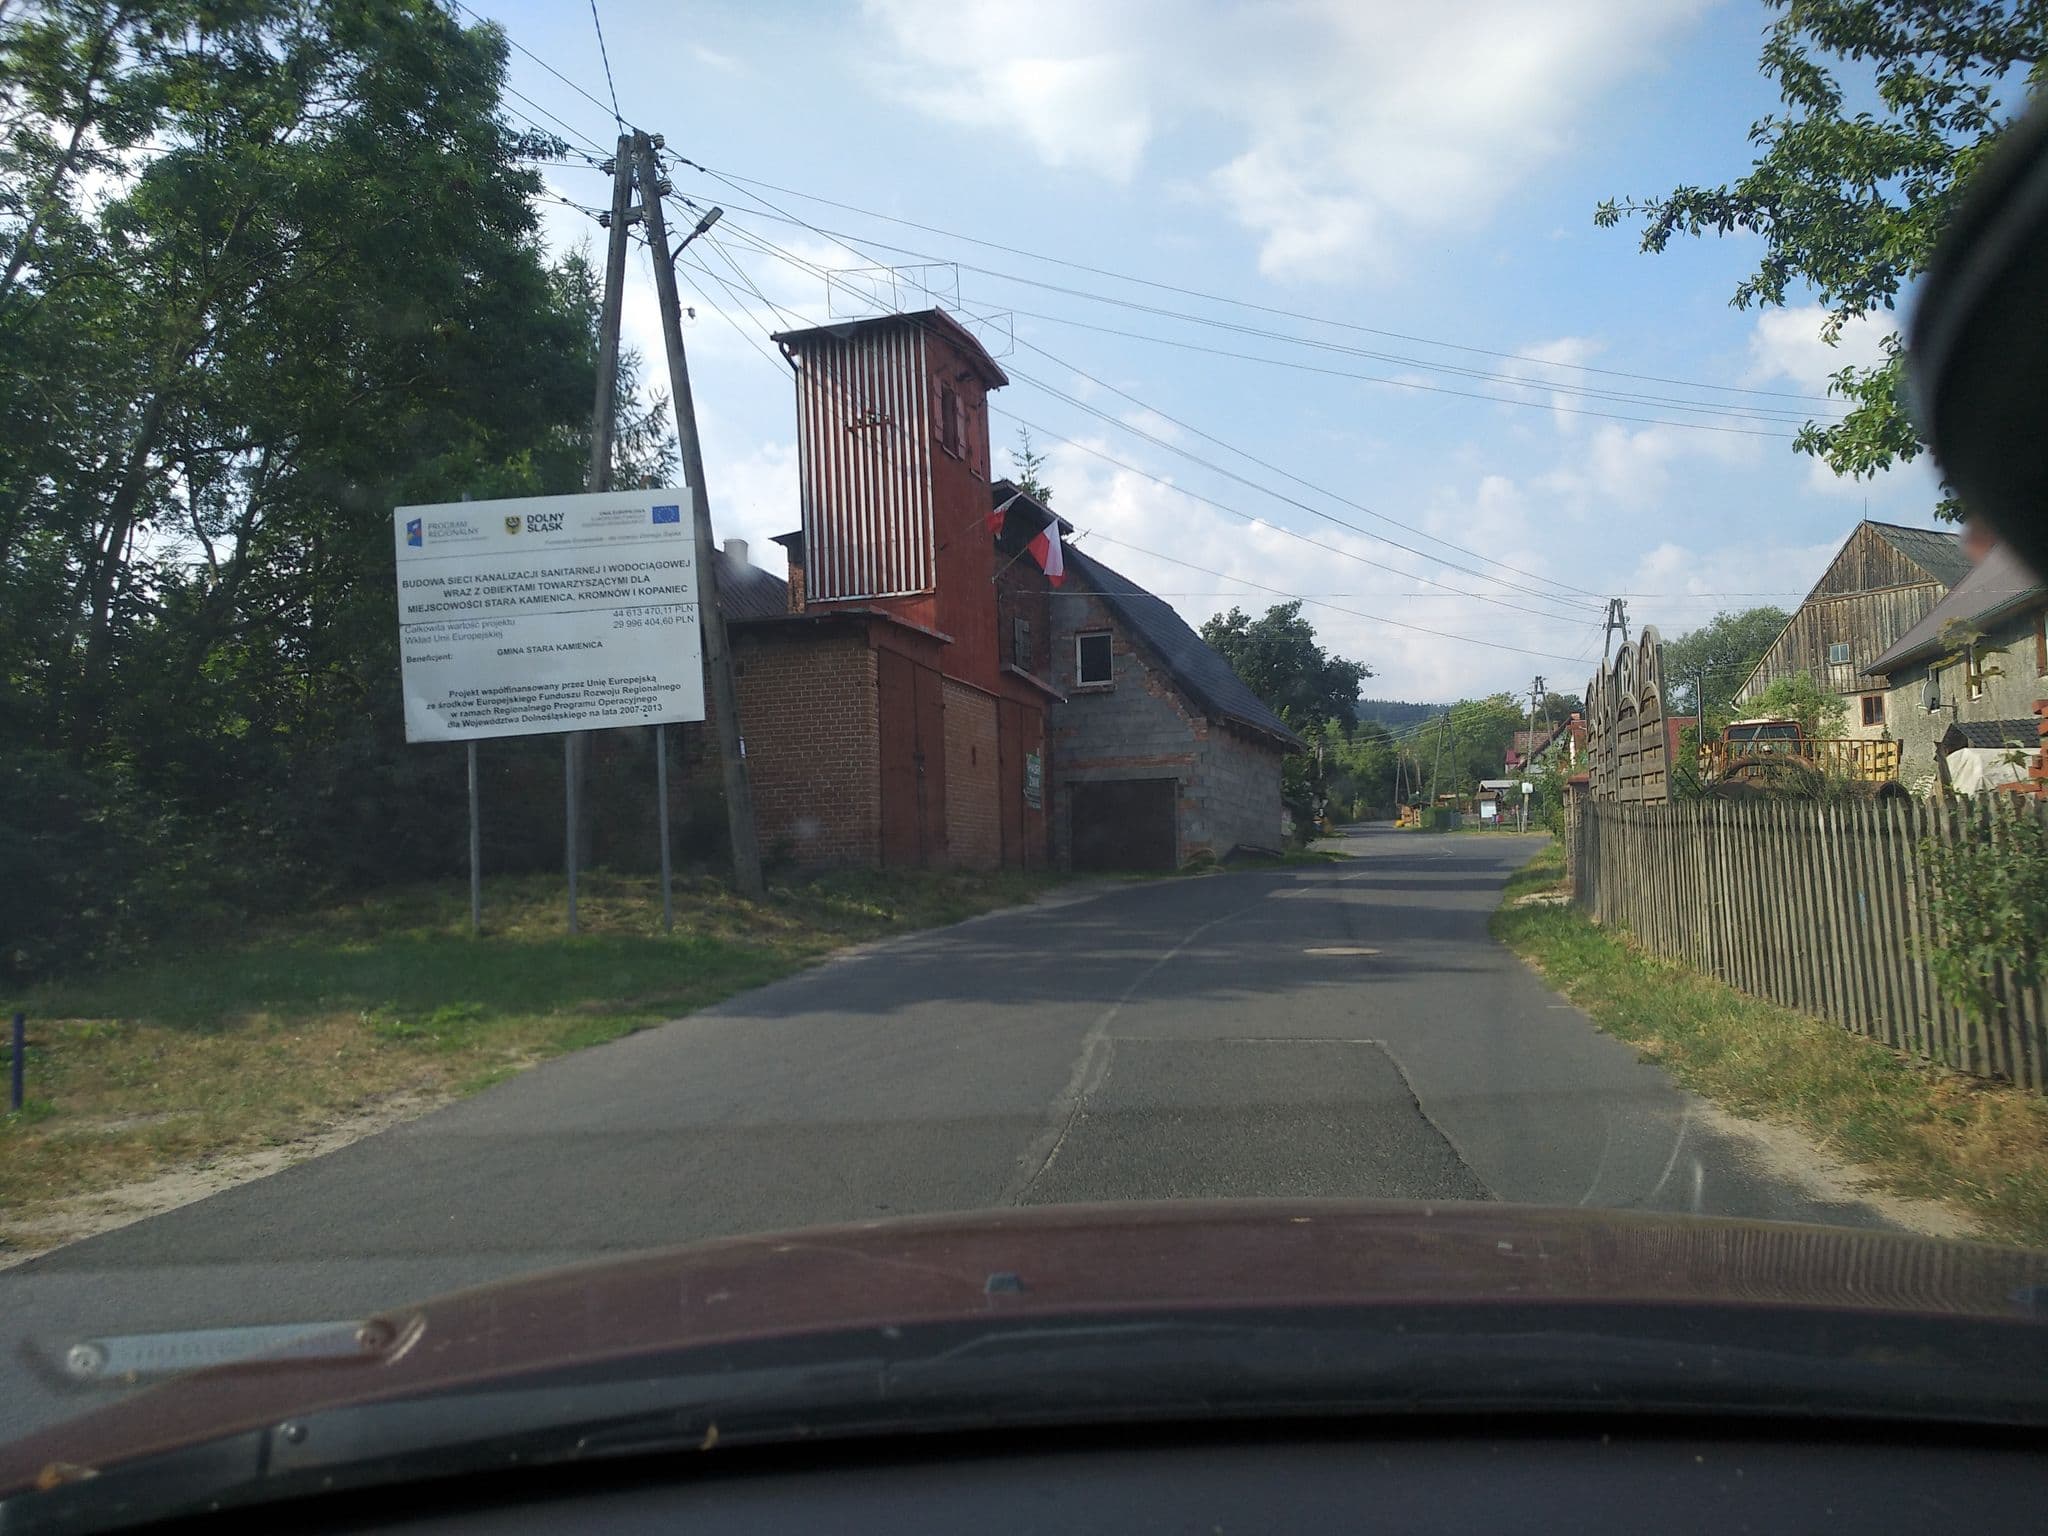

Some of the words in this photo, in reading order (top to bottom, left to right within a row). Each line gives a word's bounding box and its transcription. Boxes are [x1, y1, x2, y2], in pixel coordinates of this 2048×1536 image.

[527, 514, 564, 523] DOLNY
[402, 579, 445, 589] BUDOWA
[448, 575, 473, 584] SIECI
[475, 570, 538, 582] KANALIZACJI
[541, 566, 601, 577] SANITARNEJ
[608, 560, 690, 574] WODOCIĄGOWEJ
[444, 588, 472, 598] WRAZ
[474, 586, 481, 594] Z
[483, 583, 536, 594] OBIEKTAMI
[538, 577, 628, 591] TOWARZYSZĄCYMI
[630, 575, 650, 584] DLA
[408, 599, 482, 613] MIEJSCOWOŚCI
[485, 597, 516, 606] STARA
[578, 587, 631, 600] KROMNÓW
[638, 585, 688, 594] KOPANIEC
[452, 630, 504, 641] Europejskiej
[645, 618, 674, 627] 404,60
[676, 616, 694, 624] PLN
[481, 619, 515, 630] projektu
[626, 609, 643, 617] 613
[645, 606, 673, 616] 470,11
[676, 605, 694, 613] PLN
[406, 653, 453, 664] Beneficjent:
[497, 648, 525, 657] GMINA
[527, 645, 554, 654] STARA
[556, 641, 603, 651] KAMIENICA
[449, 689, 480, 699] Projekt
[561, 680, 585, 690] przez
[608, 675, 657, 687] Europejską
[476, 693, 538, 708] Europejskiego
[539, 691, 582, 700] Funduszu
[584, 687, 620, 698] Rozwoju
[622, 684, 681, 696] Regionalnego
[459, 707, 491, 717] ramach
[494, 703, 552, 716] Regionalnego
[554, 700, 597, 710] Programu
[599, 695, 657, 707] Operacyjnego
[462, 715, 519, 729] Województwa
[521, 711, 587, 723] Dolnośląskiego
[602, 709, 618, 717] lata
[619, 704, 663, 715] 2007-2013
